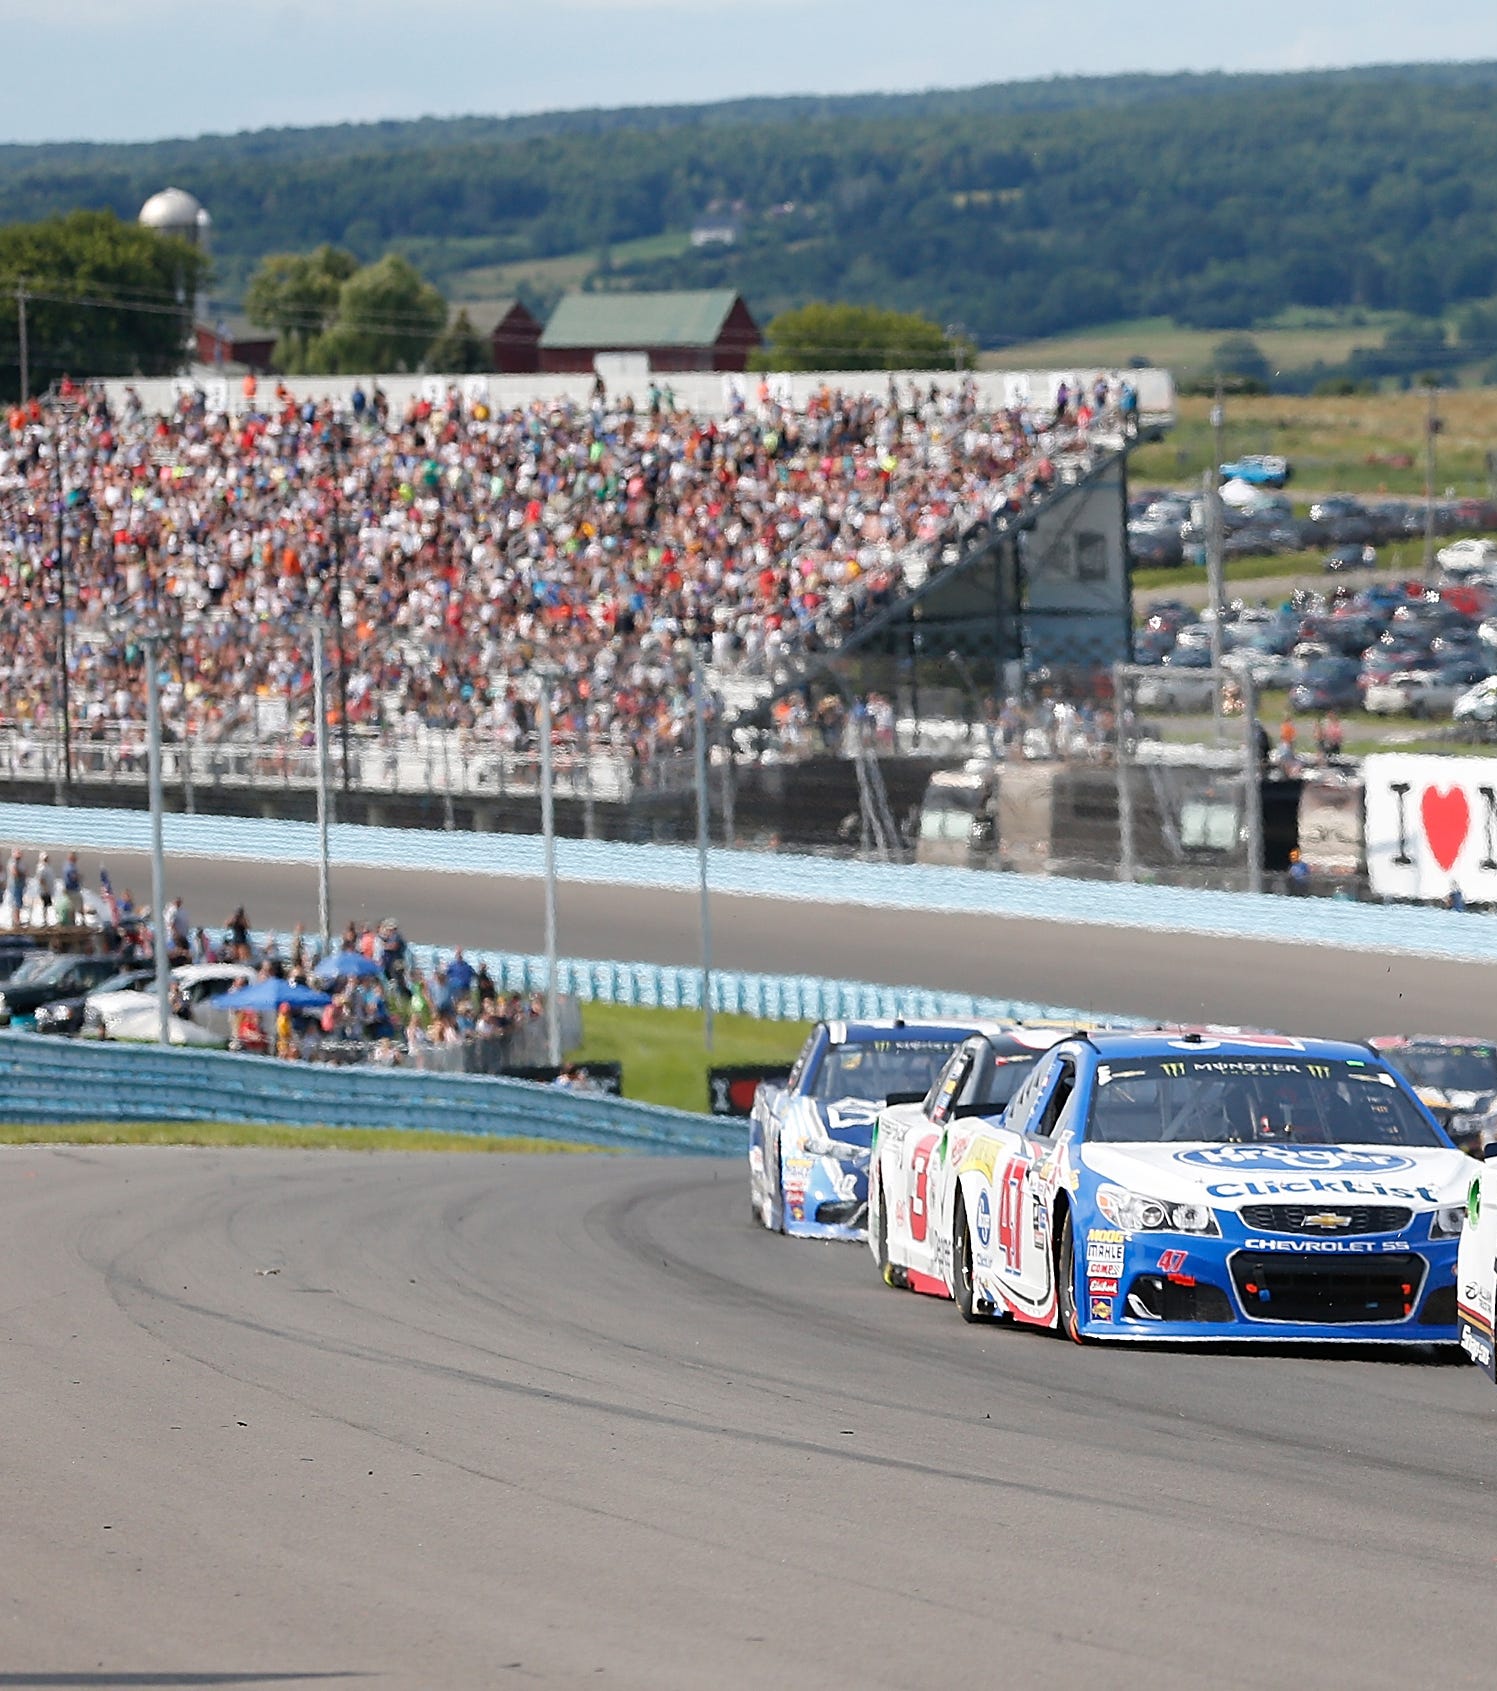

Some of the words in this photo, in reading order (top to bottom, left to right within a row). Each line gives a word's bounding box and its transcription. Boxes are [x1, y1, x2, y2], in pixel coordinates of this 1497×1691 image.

[1389, 782, 1412, 865] I
[1194, 1062, 1302, 1074] MONSTER
[1198, 1146, 1395, 1169] Kroger
[909, 1134, 940, 1243] 3
[1206, 1179, 1438, 1203] ClickList
[998, 1152, 1032, 1277] 47
[1088, 1229, 1126, 1243] MOOG
[1245, 1239, 1376, 1252] CHEVROLET
[1382, 1241, 1410, 1251] SS
[1089, 1244, 1122, 1259] MAHLE
[1157, 1249, 1189, 1273] 47
